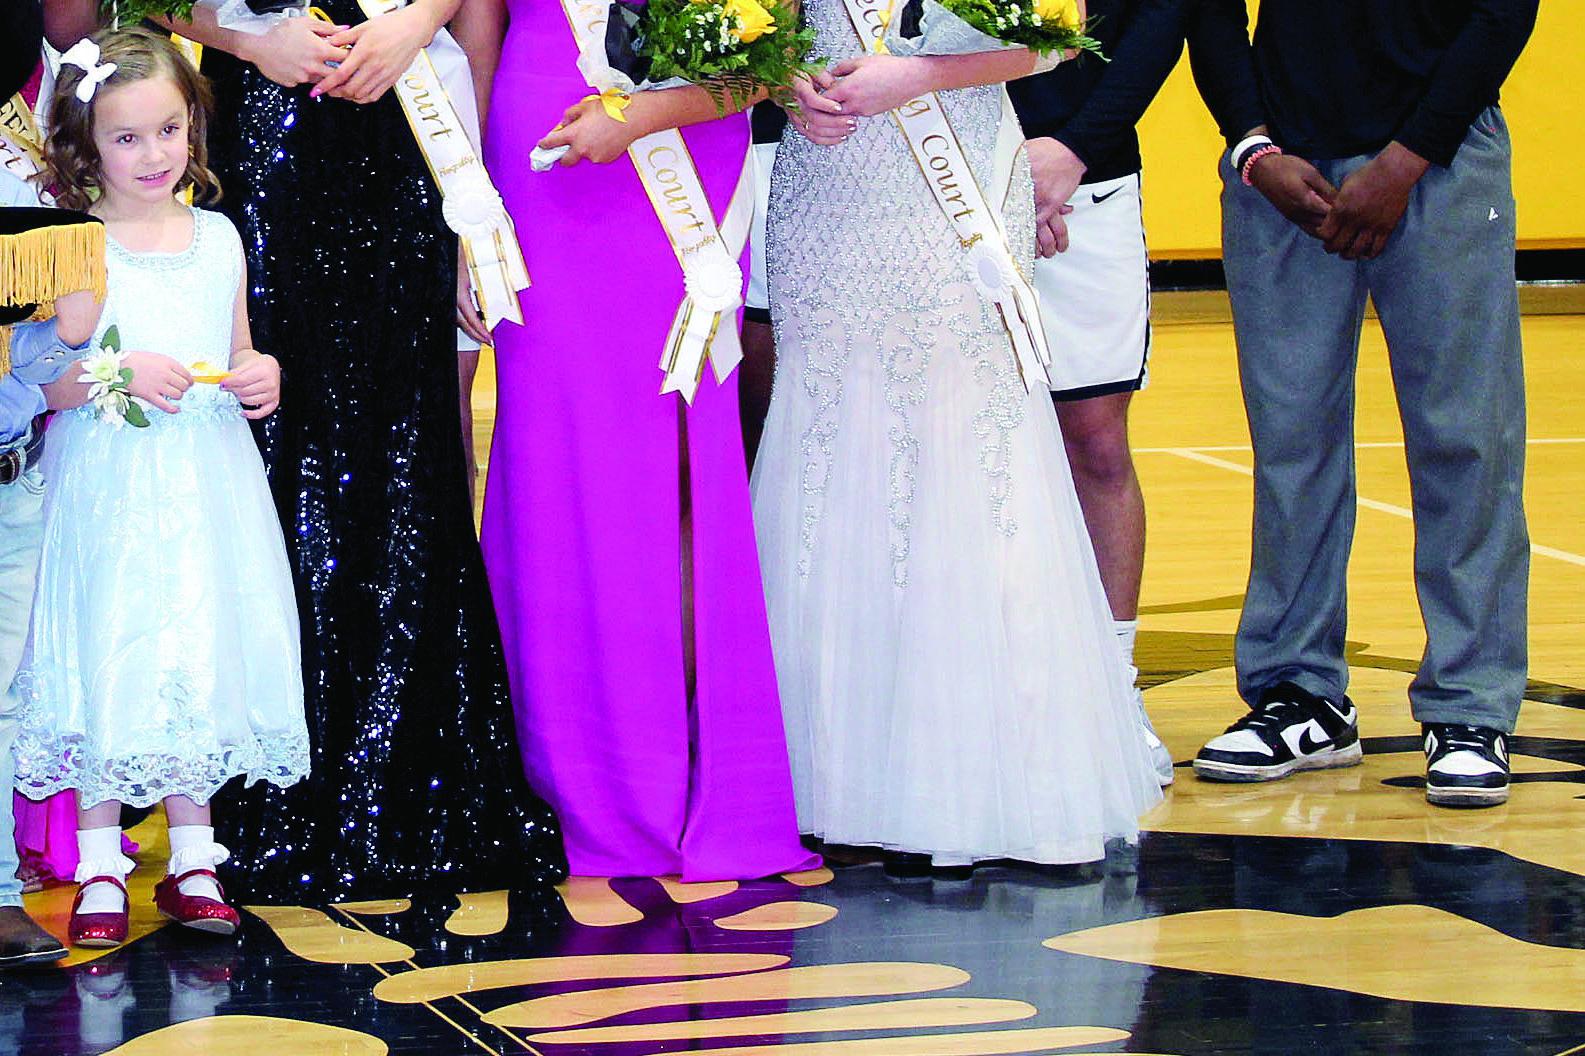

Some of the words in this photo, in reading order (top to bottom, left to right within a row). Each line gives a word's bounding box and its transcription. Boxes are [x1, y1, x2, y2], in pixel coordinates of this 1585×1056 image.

[405, 64, 454, 142] ourt
[647, 145, 706, 235] Court
[921, 134, 976, 224] Court
